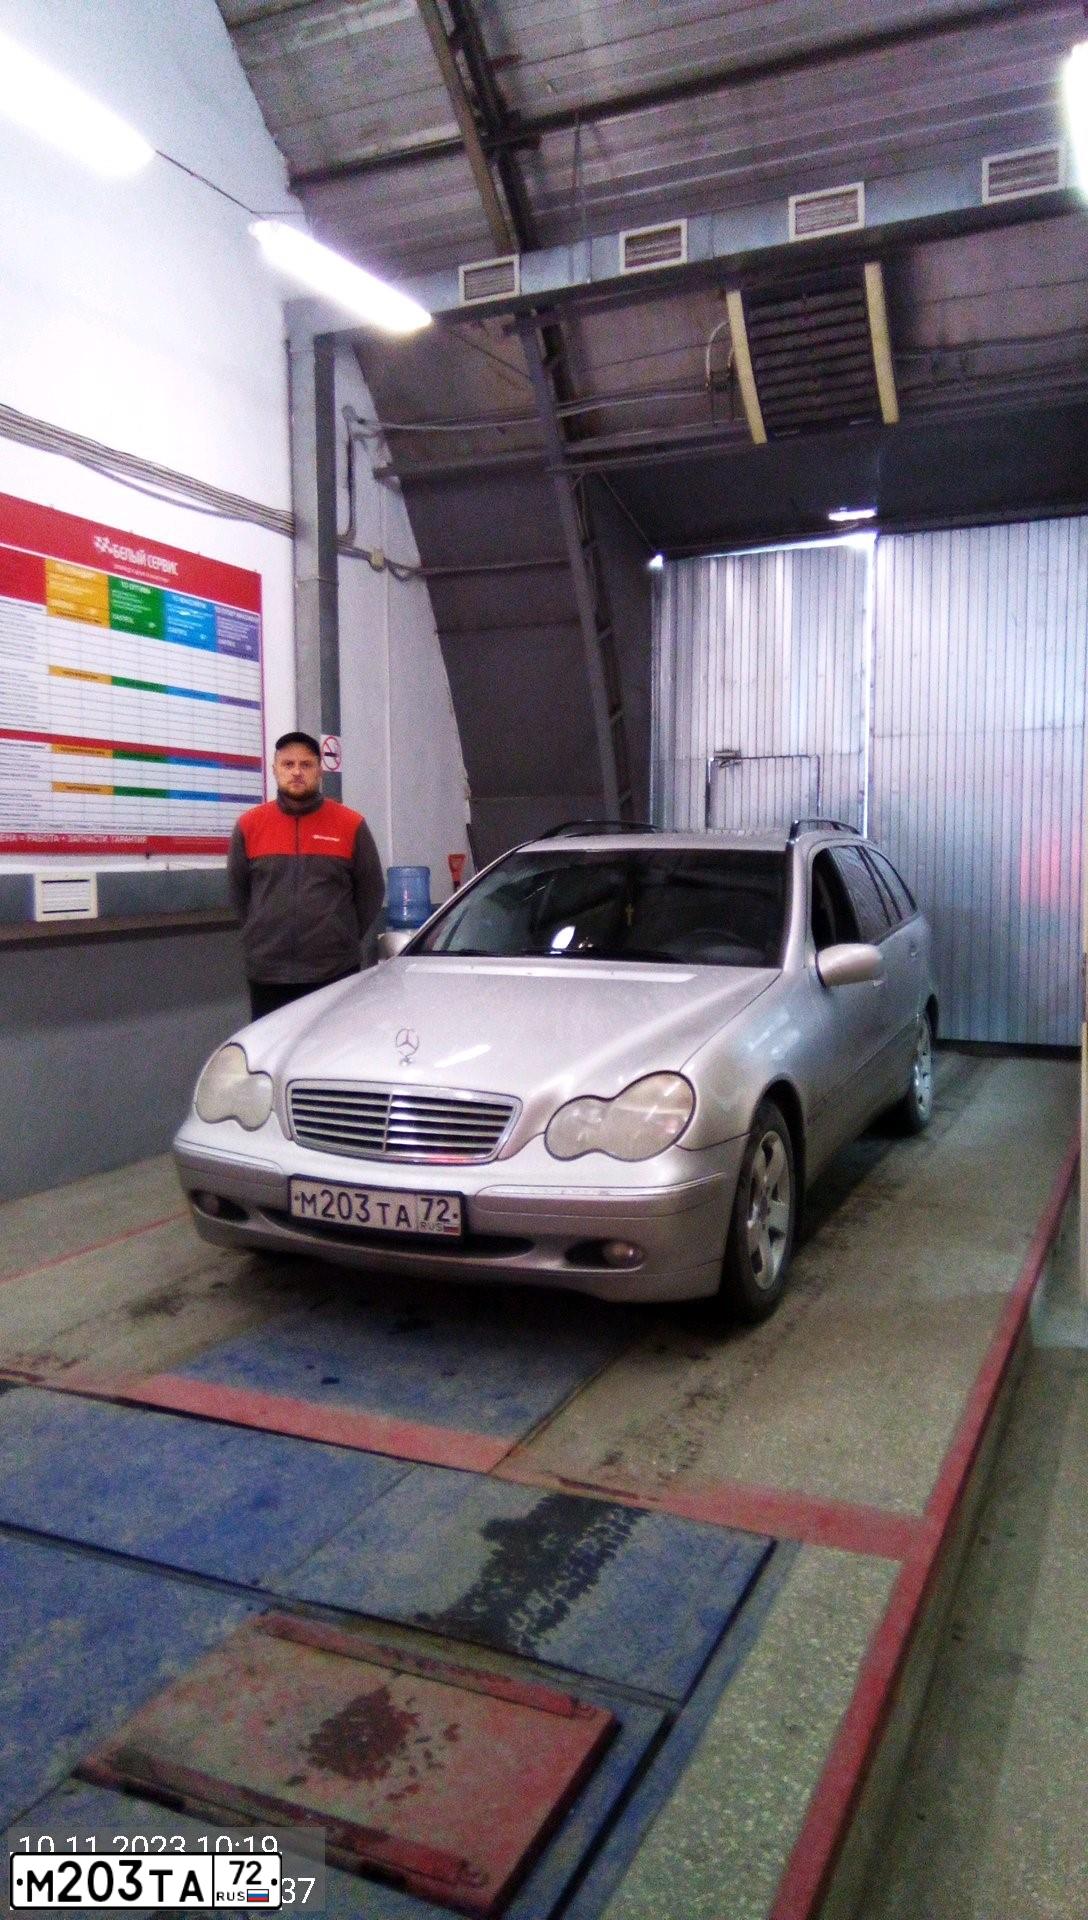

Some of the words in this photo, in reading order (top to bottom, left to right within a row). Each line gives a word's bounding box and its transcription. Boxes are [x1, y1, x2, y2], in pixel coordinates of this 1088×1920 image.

[112, 544, 146, 566] БЕЛЫЙ
[147, 555, 179, 576] СЕРВИС
[0, 832, 16, 842] ЕНА
[300, 1189, 411, 1228] М203ТА
[421, 1197, 450, 1223] 72
[420, 1221, 443, 1232] RUS
